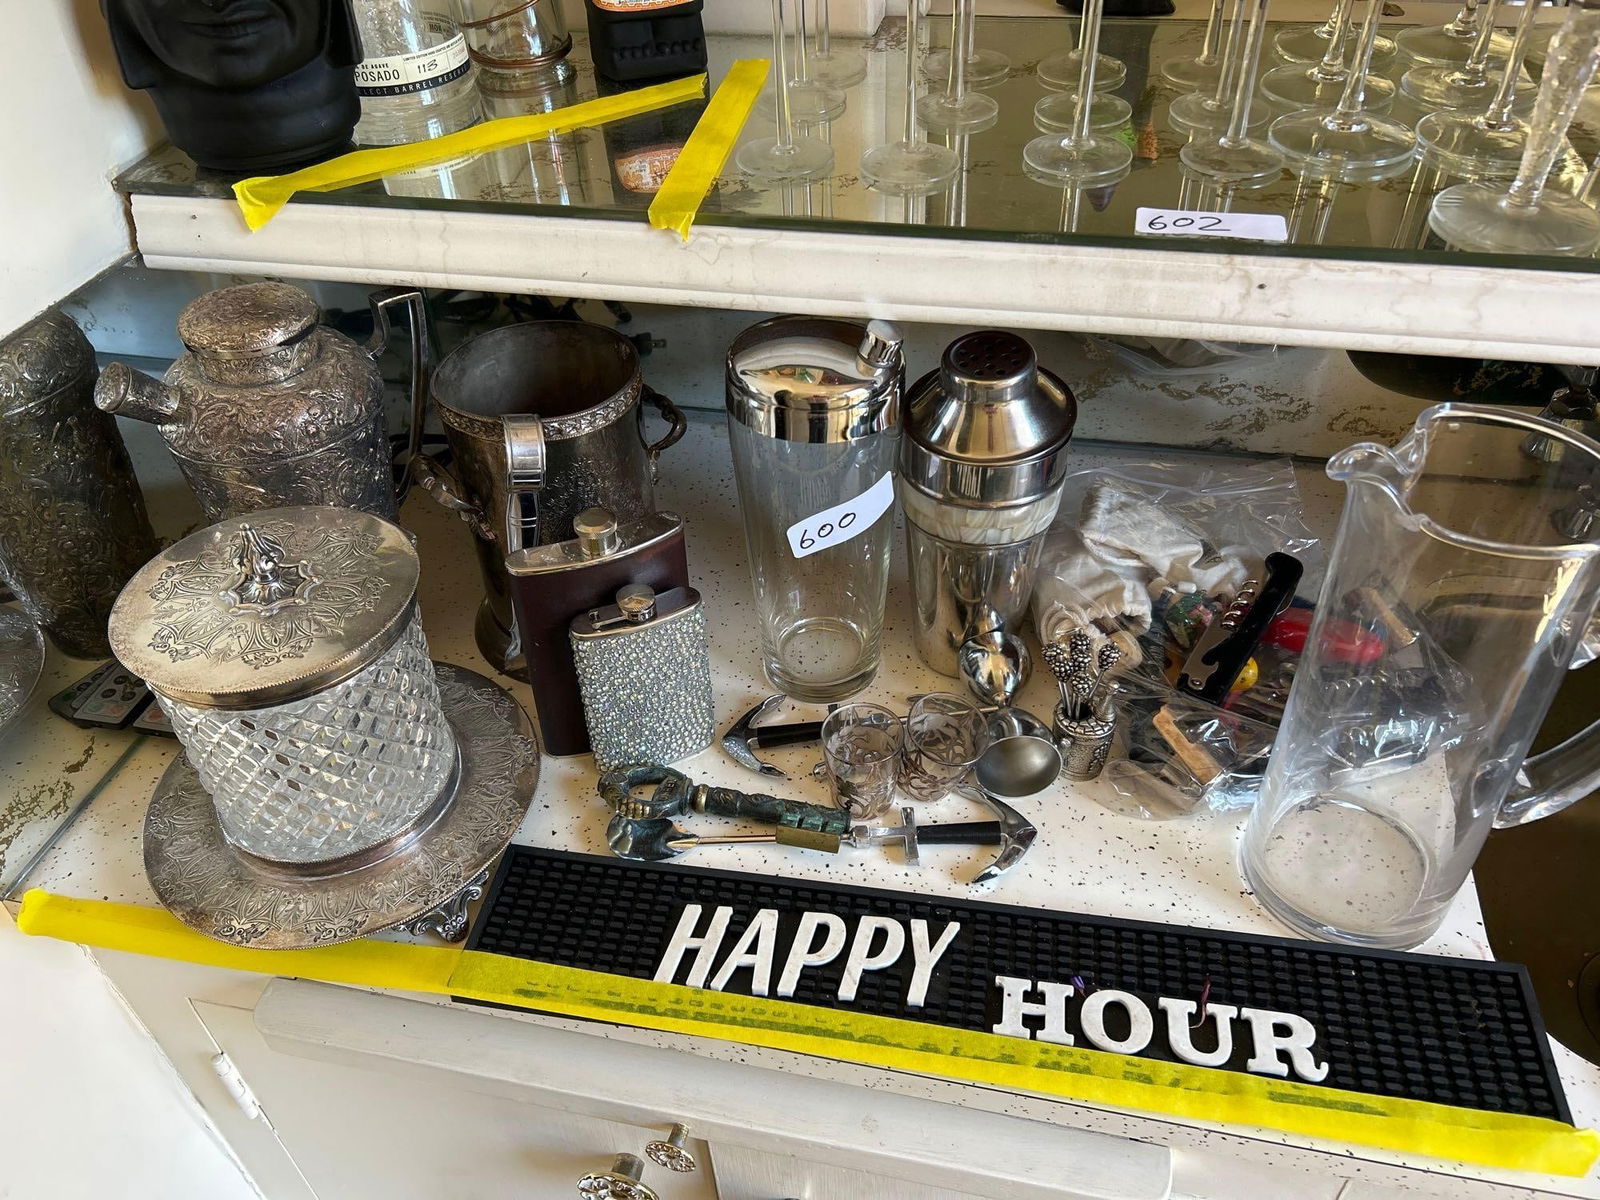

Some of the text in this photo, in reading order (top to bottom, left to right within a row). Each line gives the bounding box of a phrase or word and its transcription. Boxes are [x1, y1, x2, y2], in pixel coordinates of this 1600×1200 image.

[417, 59, 438, 74] 113
[395, 81, 433, 93] BARREL
[1148, 215, 1231, 231] 602
[800, 512, 856, 549] 600
[652, 903, 1329, 1082] HAPPY HOUR
